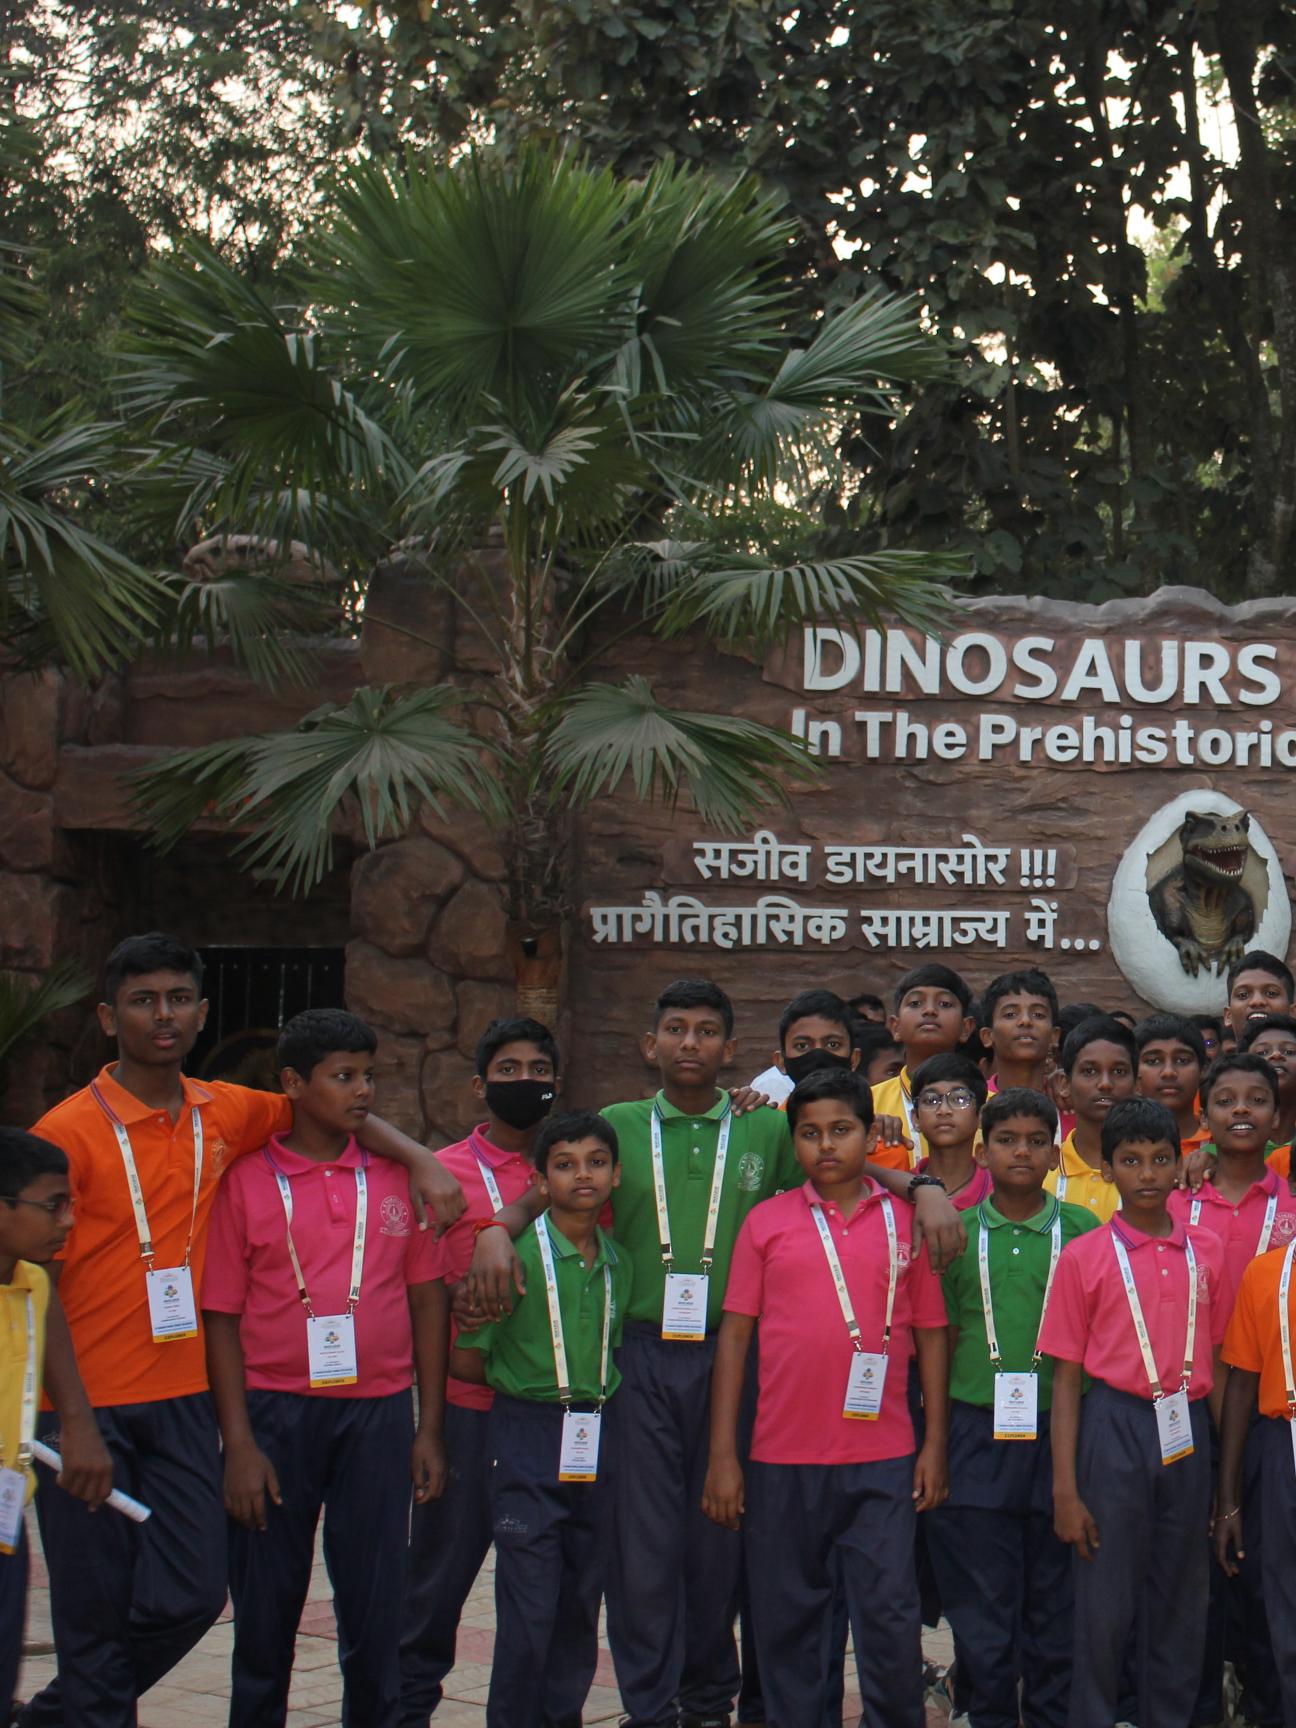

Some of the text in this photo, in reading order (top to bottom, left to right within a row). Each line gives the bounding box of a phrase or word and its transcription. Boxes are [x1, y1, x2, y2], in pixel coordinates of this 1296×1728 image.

[803, 627, 1282, 705] DINOSAURS
[791, 708, 842, 757] In
[854, 711, 968, 761] The
[693, 829, 812, 883] सजीव
[824, 833, 1011, 887] डायनासोर
[590, 891, 849, 950] प्रागैतिहासिक
[861, 907, 1010, 948] साम्राज्य
